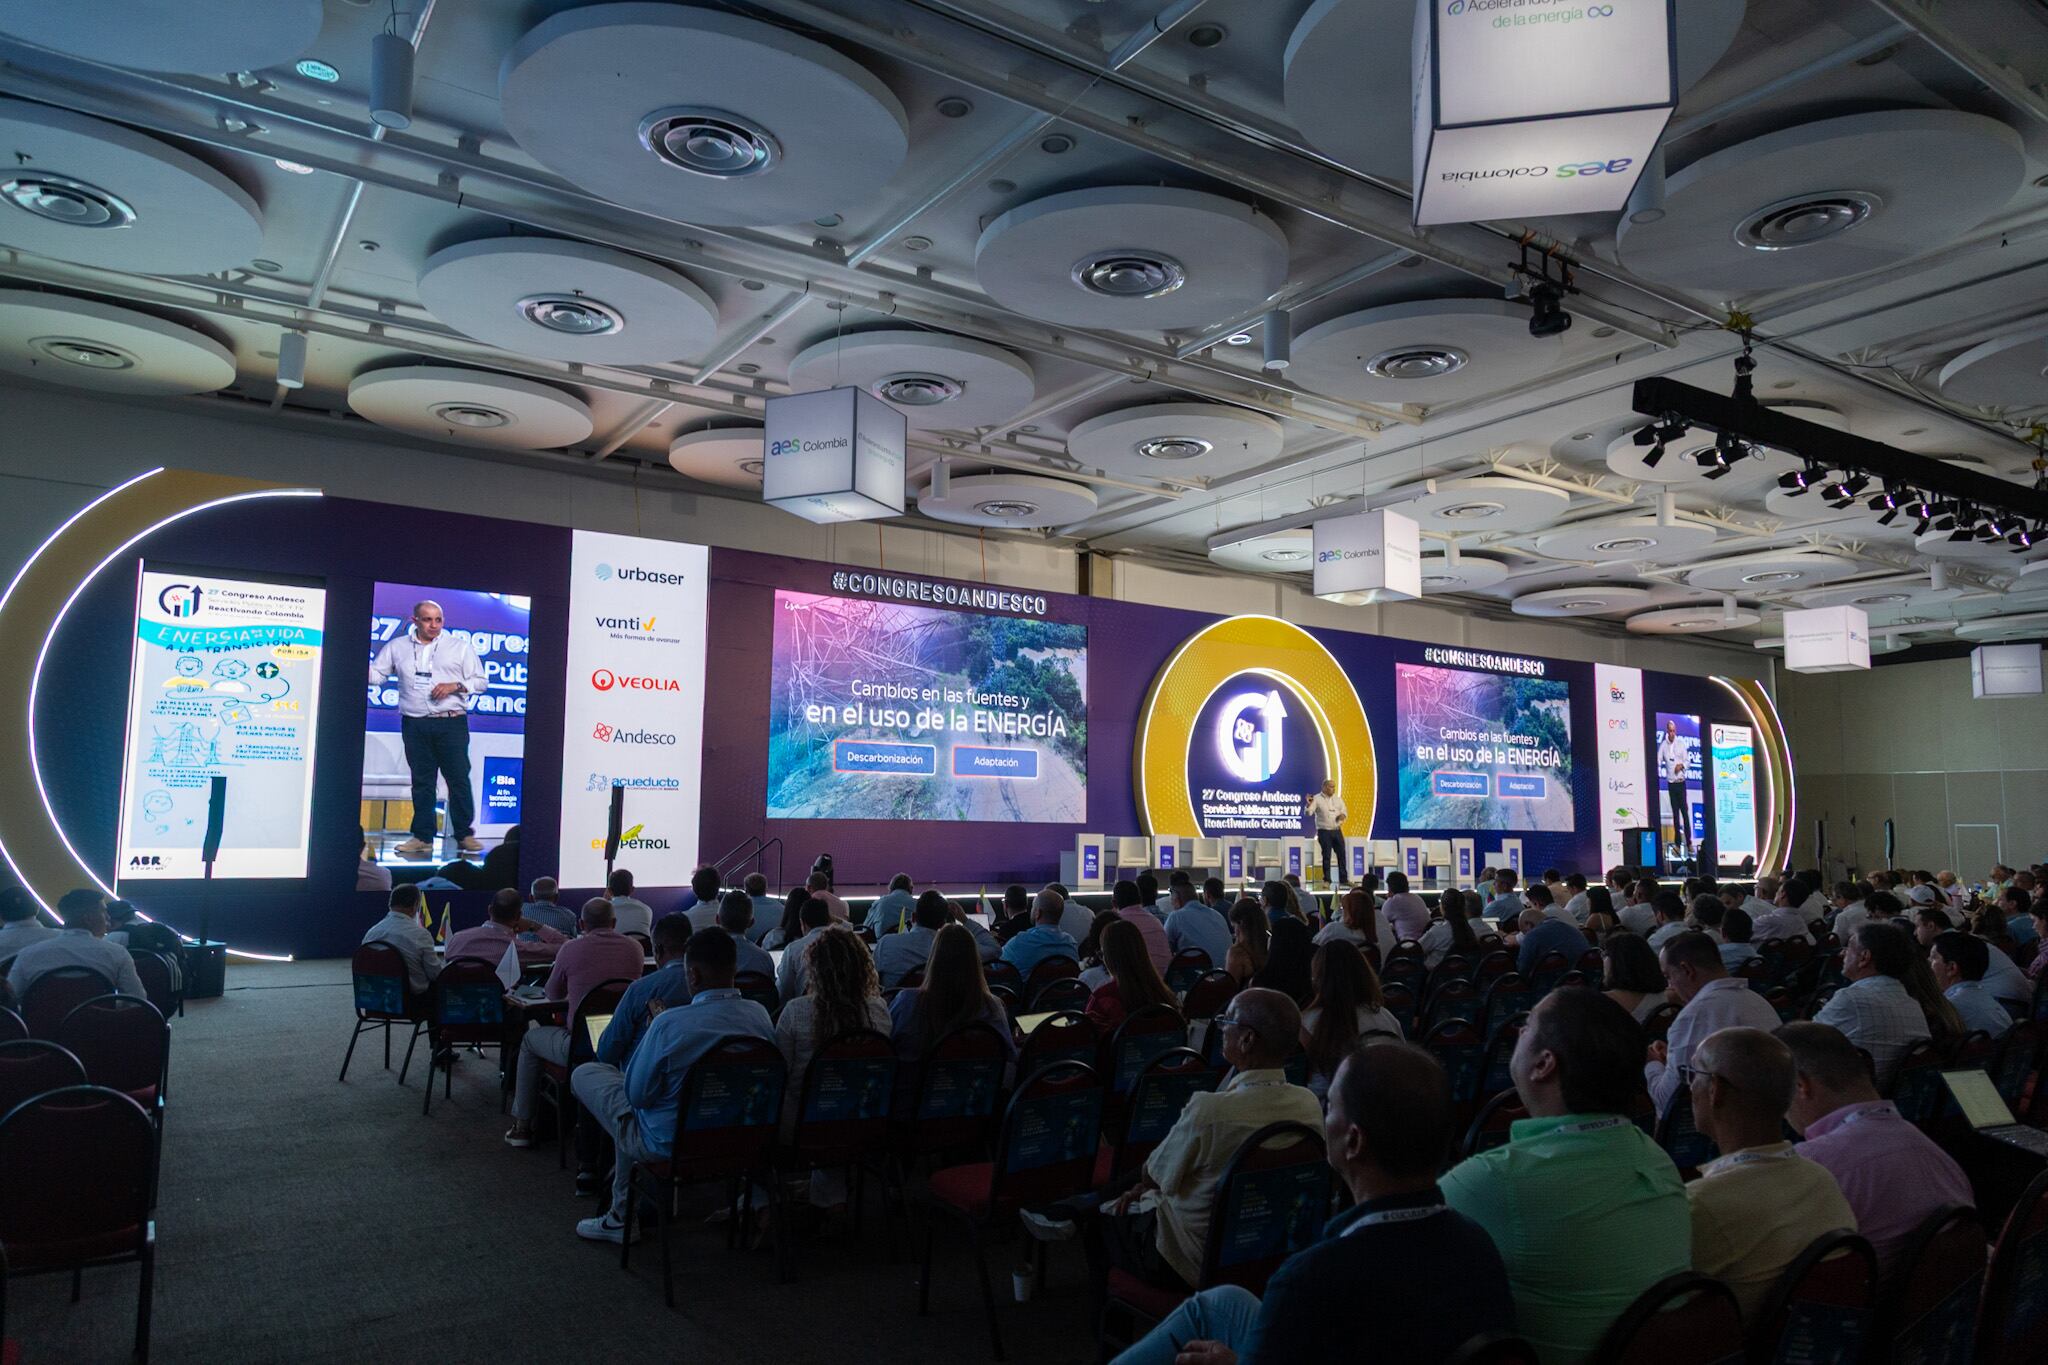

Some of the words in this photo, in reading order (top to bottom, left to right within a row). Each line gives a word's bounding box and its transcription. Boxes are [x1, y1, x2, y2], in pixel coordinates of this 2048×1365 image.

[1492, 15, 1511, 28] de
[1514, 14, 1526, 26] la
[1528, 7, 1583, 23] energía
[1441, 165, 1548, 181] Colombia
[771, 438, 800, 456] aes
[803, 437, 848, 452] Colombia
[1318, 549, 1342, 563] aes
[1343, 547, 1380, 560] Colombia
[618, 567, 684, 585] urbaser
[221, 590, 265, 601] Congreso
[267, 594, 305, 603] Andesco
[832, 571, 1047, 615] #CONGRESOANDESCO
[208, 605, 263, 615] Reactivando
[264, 609, 304, 619] Colombia
[596, 617, 640, 630] vanti
[265, 628, 305, 640] VIDA
[205, 637, 291, 654] TRANSICIÓN
[1424, 648, 1544, 676] #CONGRESOANDESCO
[618, 676, 680, 691] VEOLIA
[851, 679, 918, 700] Cambios
[922, 687, 940, 700] en
[944, 687, 962, 703] las
[966, 688, 1019, 707] fuentes
[1020, 695, 1030, 710] y
[806, 706, 837, 724] en
[843, 703, 863, 726] el
[869, 709, 911, 728] uso
[916, 707, 944, 730] de
[950, 710, 968, 732] la
[974, 710, 1067, 738] ENERGÍA
[613, 729, 676, 745] Andesco
[1439, 726, 1477, 742] Cambios
[1478, 732, 1489, 742] en
[1490, 731, 1501, 743] las
[1503, 731, 1533, 746] fuentes
[1533, 736, 1540, 747] y
[847, 751, 924, 765] Descarbonización
[974, 756, 1019, 768] Adaptación
[1417, 747, 1434, 760] en
[1437, 744, 1448, 761] el
[1450, 748, 1474, 762] uso
[1476, 747, 1493, 763] de
[1495, 748, 1506, 764] la
[1508, 747, 1561, 767] ENERGÍA
[611, 777, 679, 788] acueducto
[1440, 780, 1482, 789] Descarbonización
[1202, 789, 1215, 800] 27
[1215, 789, 1261, 803] Congreso
[1261, 790, 1301, 803] Andesco
[1202, 803, 1237, 814] Servicios
[1238, 804, 1270, 815] Públicos
[1271, 805, 1283, 815] TIC
[1290, 805, 1301, 815] TV
[1204, 817, 1260, 829] Reactivando
[1261, 818, 1301, 829] Colombia
